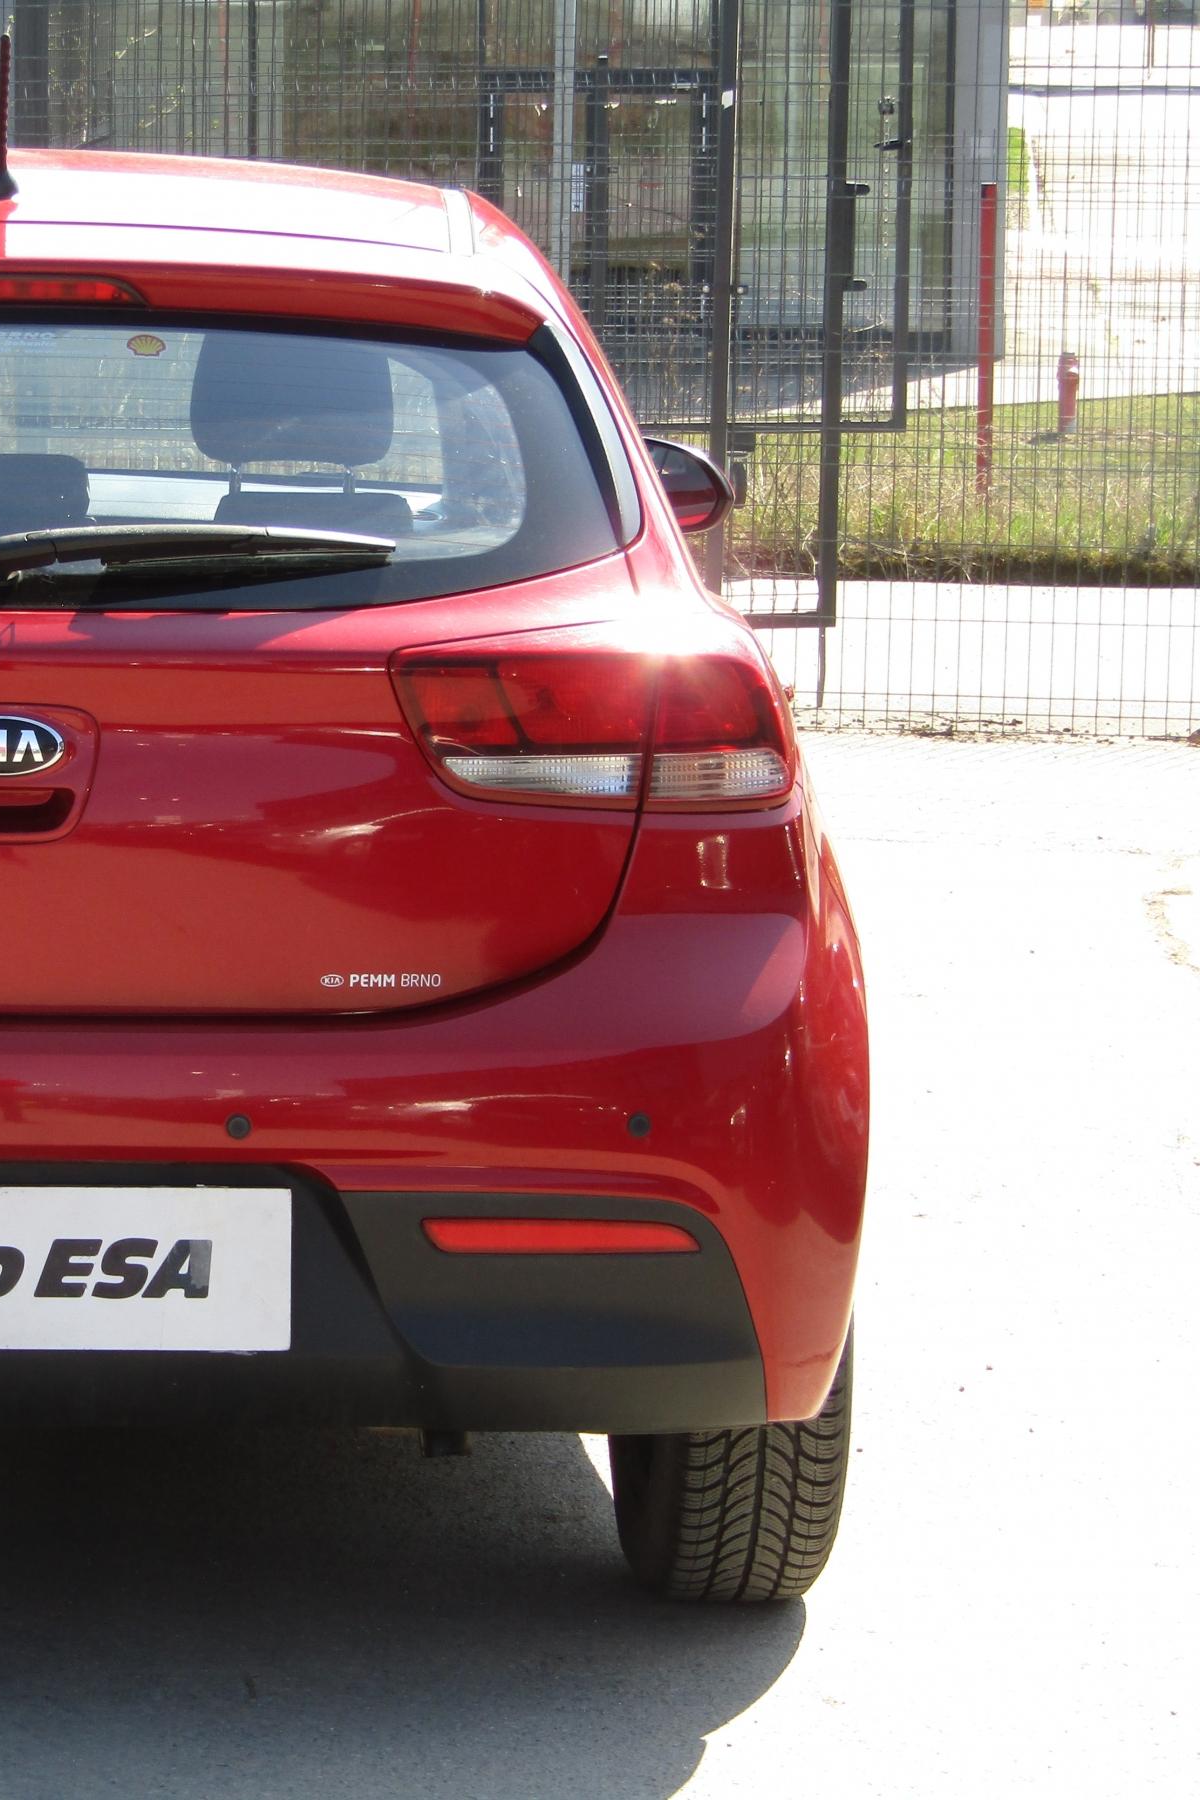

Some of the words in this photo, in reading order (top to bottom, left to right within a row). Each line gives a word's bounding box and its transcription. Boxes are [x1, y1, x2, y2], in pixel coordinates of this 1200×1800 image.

[349, 973, 395, 987] PEMM
[400, 973, 442, 988] BRNO
[33, 1237, 214, 1300] ESA
